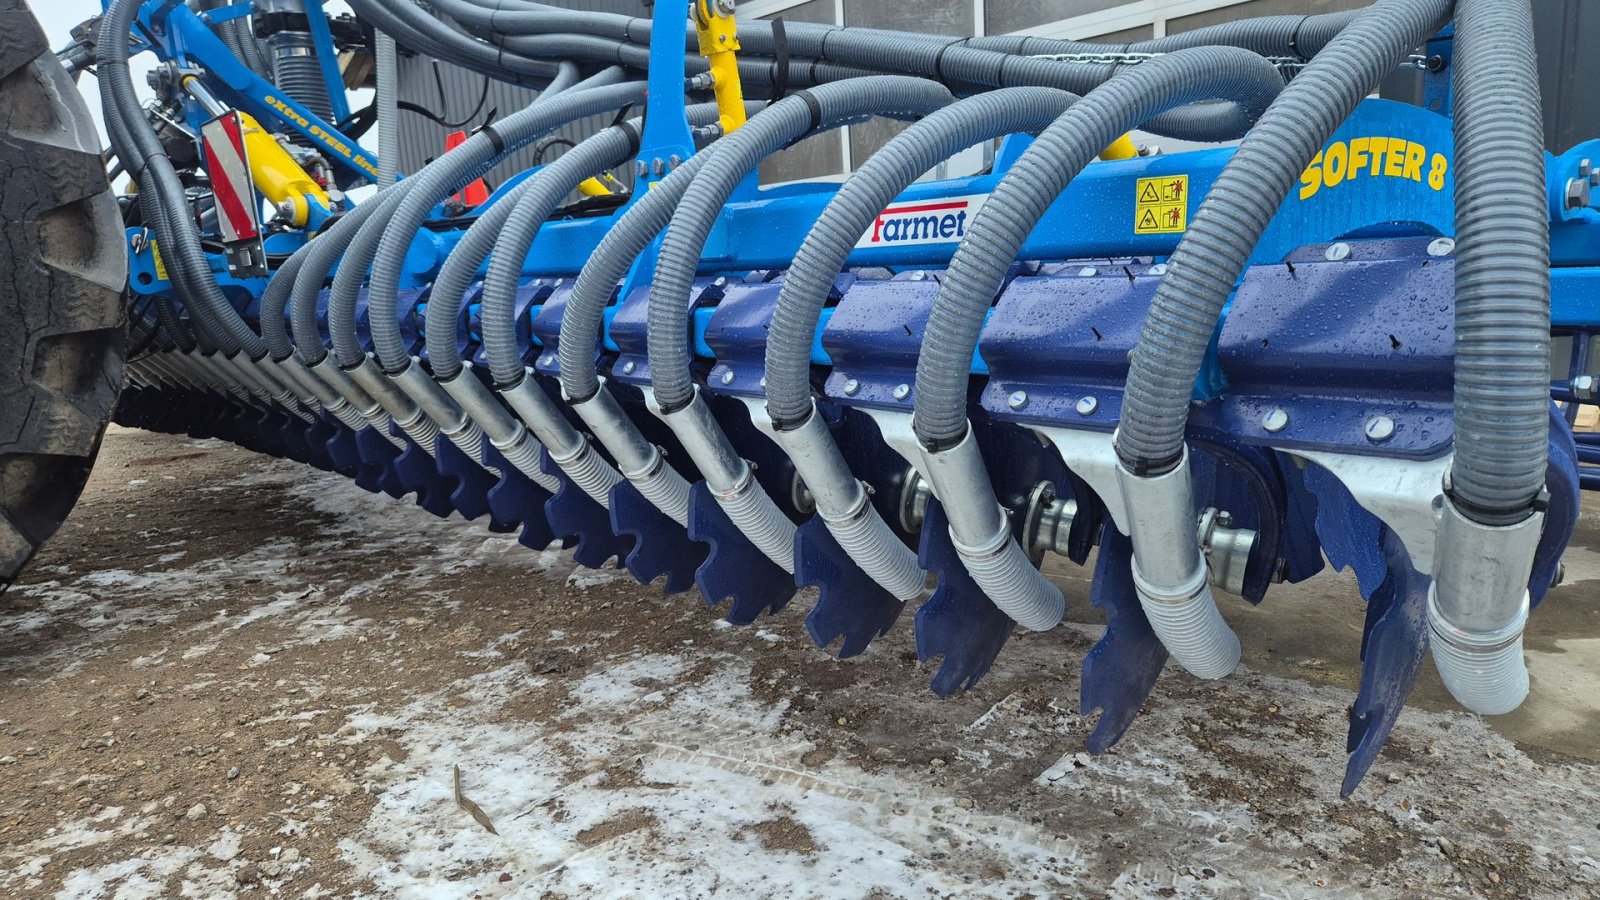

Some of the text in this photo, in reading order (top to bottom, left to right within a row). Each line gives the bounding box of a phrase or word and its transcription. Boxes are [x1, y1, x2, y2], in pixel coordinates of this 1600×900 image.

[308, 125, 352, 158] STEEL
[1300, 136, 1448, 200] SOFTER 8
